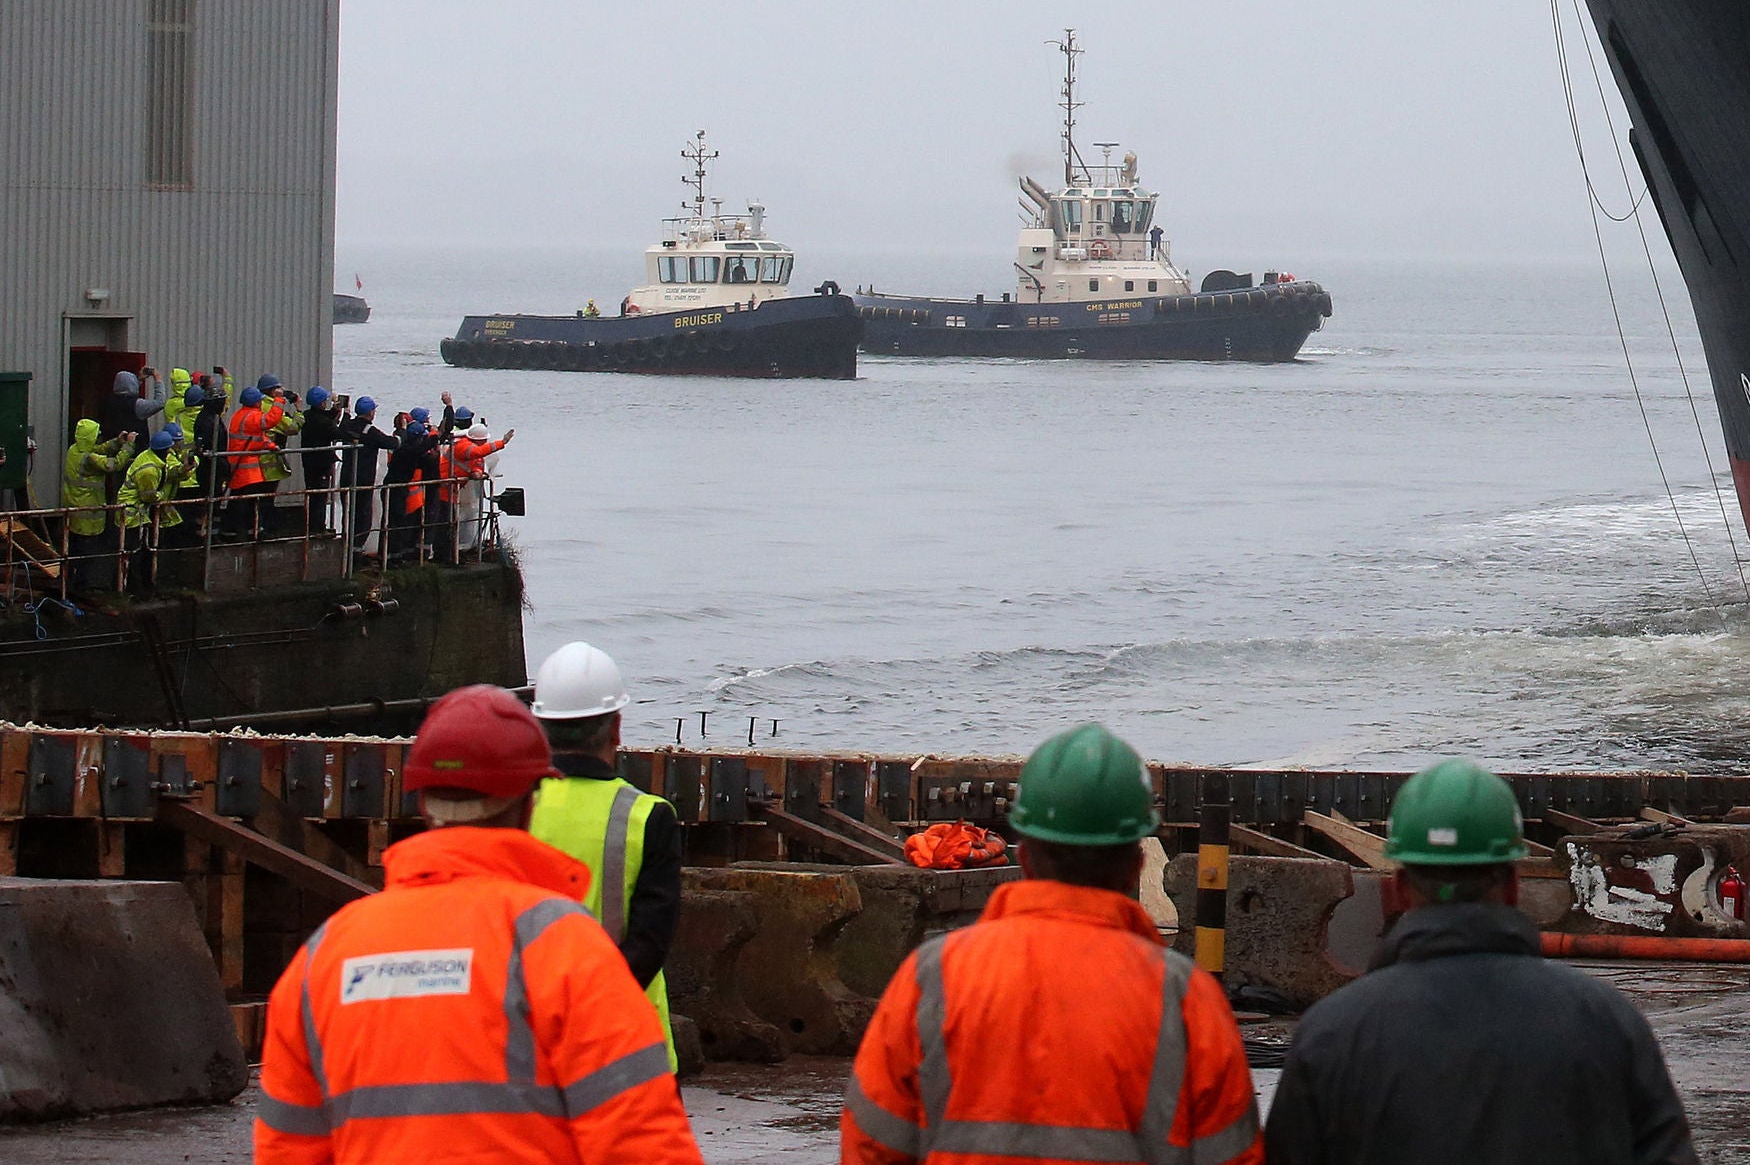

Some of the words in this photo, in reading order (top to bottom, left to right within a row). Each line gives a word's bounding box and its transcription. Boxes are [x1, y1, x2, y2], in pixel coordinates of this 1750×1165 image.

[1107, 301, 1142, 310] WARRIOR
[485, 320, 515, 329] BRUISER
[674, 313, 722, 328] BRUISER
[378, 960, 468, 977] FERGUSON
